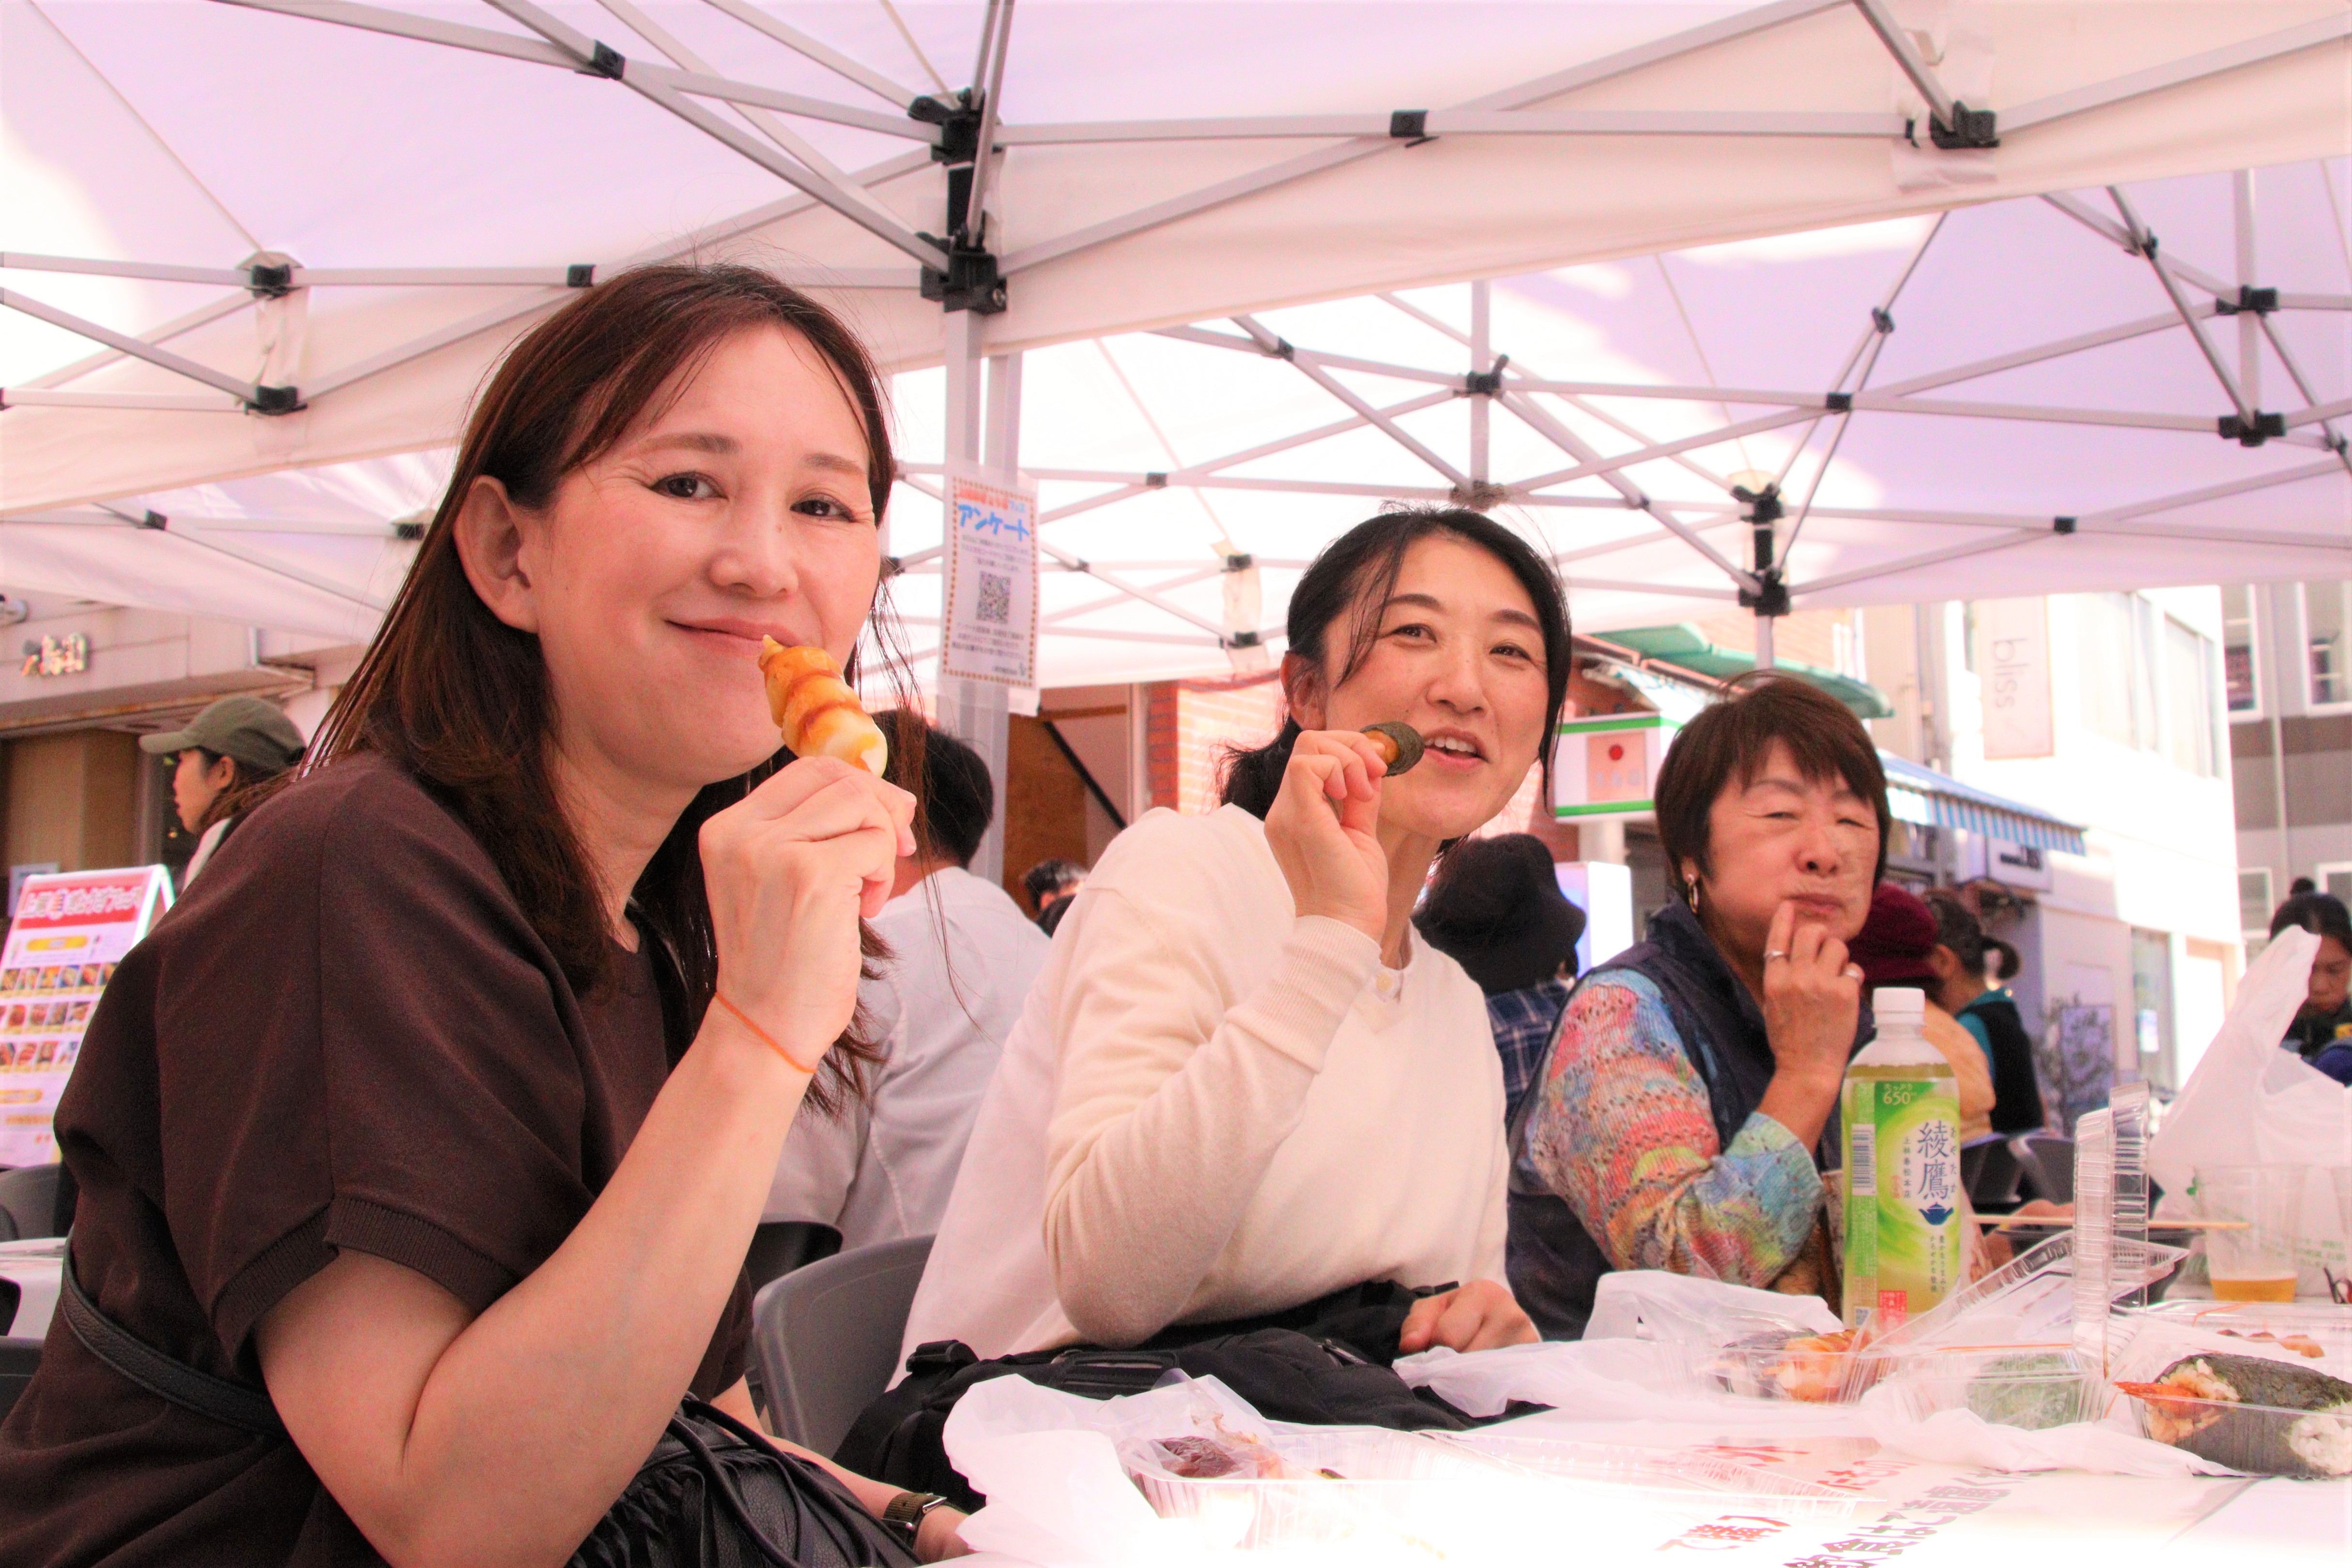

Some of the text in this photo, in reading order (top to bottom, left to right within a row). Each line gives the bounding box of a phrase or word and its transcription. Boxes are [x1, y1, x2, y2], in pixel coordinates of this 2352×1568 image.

[958, 504, 1030, 541] アンケート
[1994, 638, 2030, 708] bliss
[1883, 1091, 1911, 1105] 650
[1918, 1120, 1949, 1199] 綾鷹
